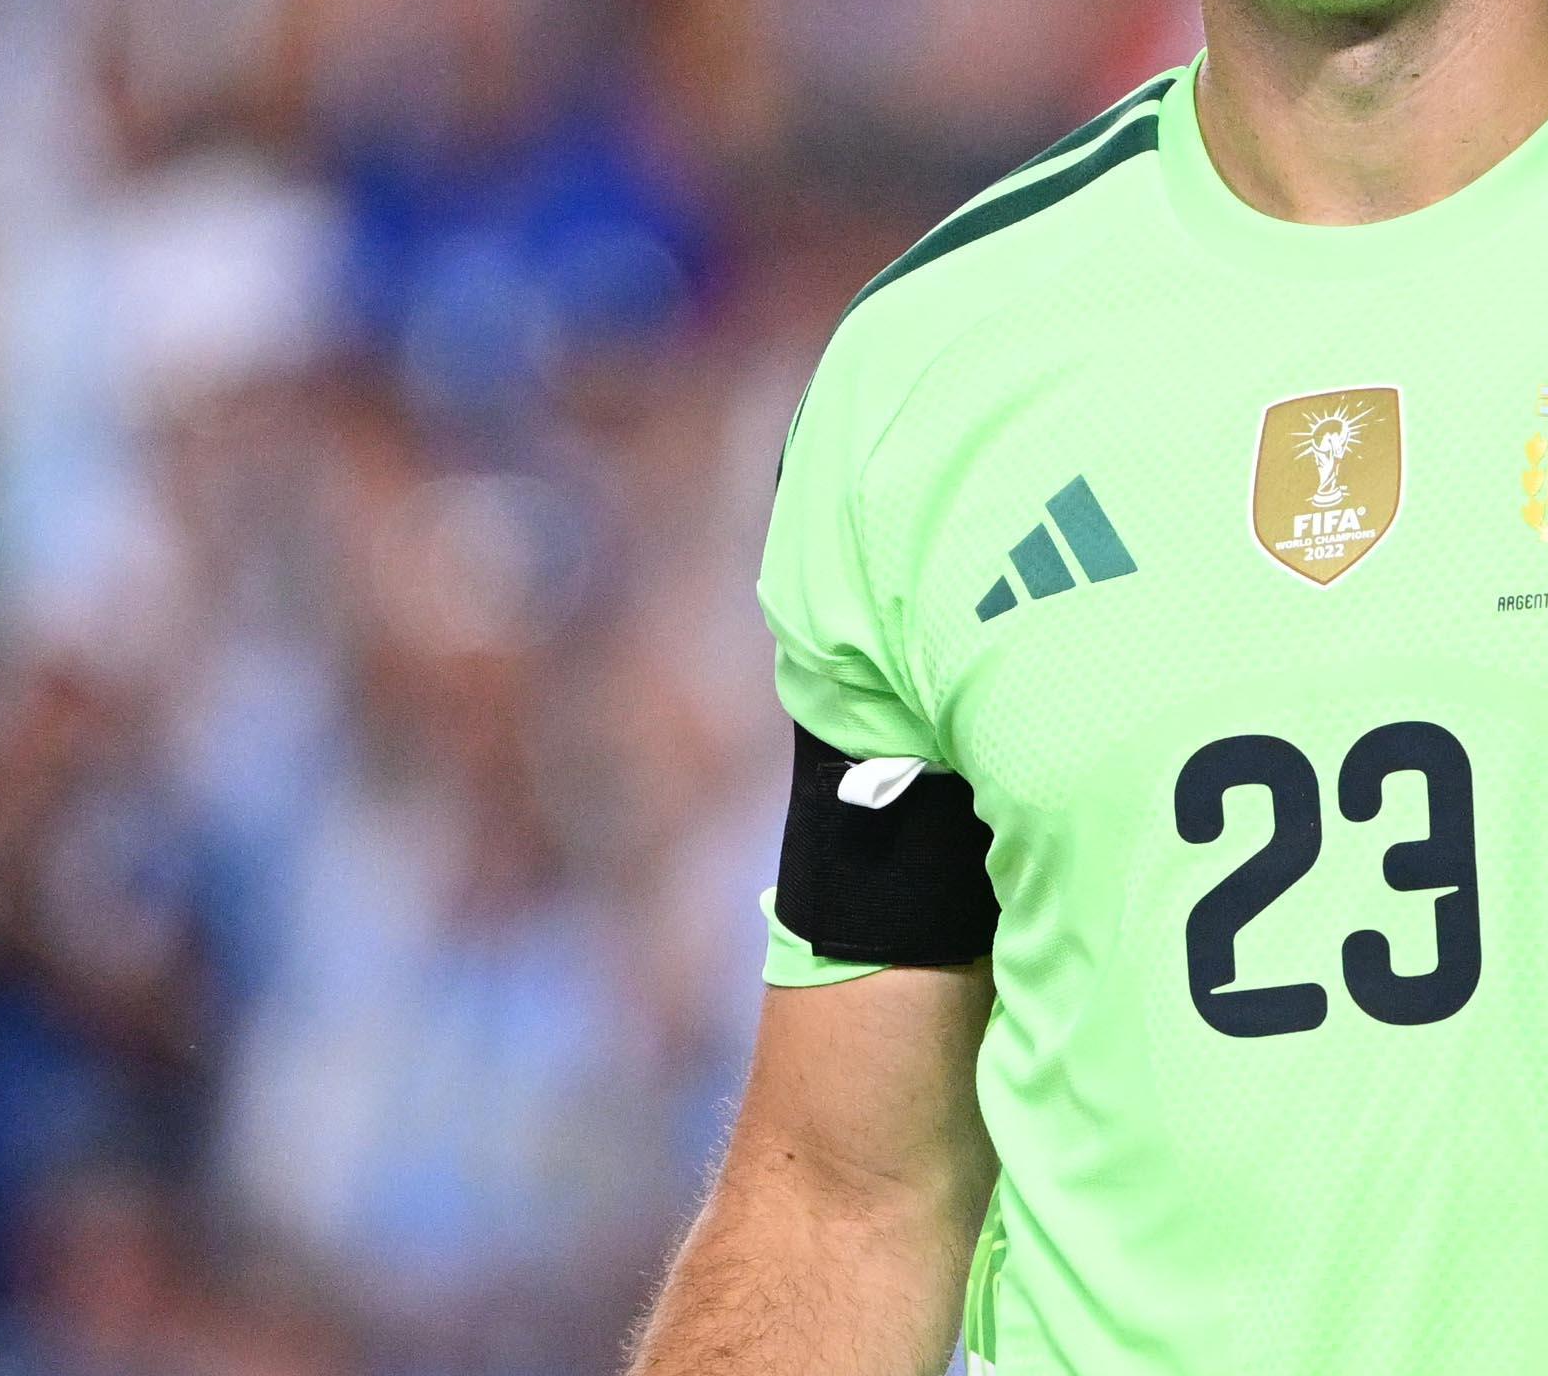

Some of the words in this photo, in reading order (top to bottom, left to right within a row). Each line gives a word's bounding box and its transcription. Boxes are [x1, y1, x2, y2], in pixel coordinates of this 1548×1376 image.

[1275, 536, 1313, 551] WORLD
[1314, 529, 1377, 545] CHAMPIONS
[1304, 543, 1345, 561] 2022
[1174, 721, 1482, 1038] 23
